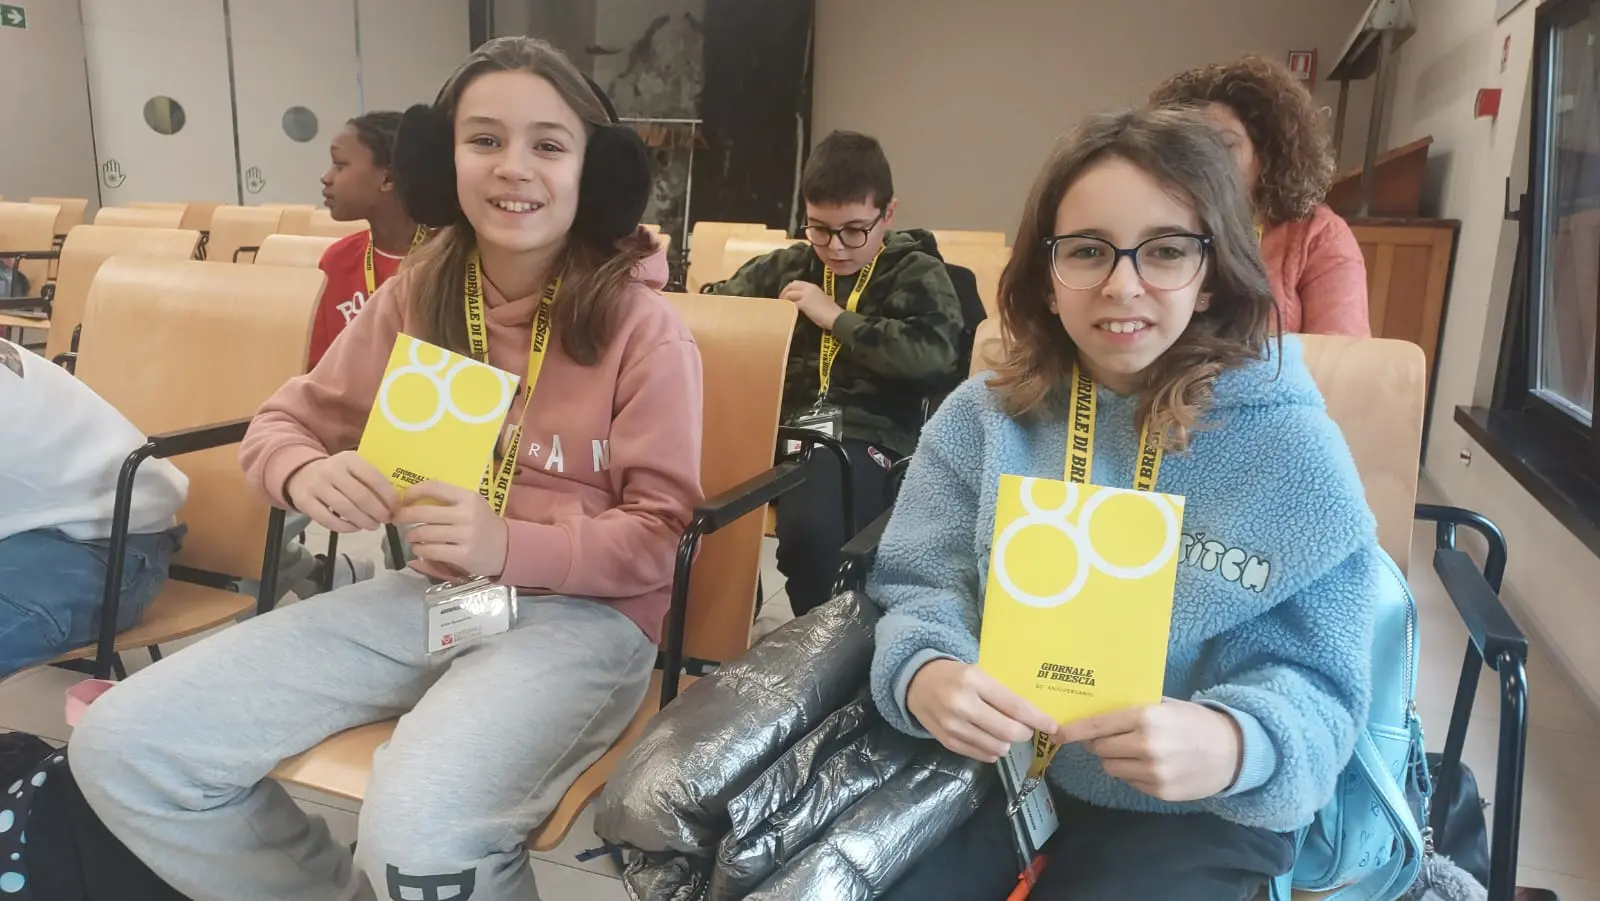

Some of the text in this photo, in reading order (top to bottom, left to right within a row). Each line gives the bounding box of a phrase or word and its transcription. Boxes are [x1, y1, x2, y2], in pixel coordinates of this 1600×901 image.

[467, 262, 481, 321] GIORNALE
[470, 322, 482, 337] DI
[1075, 375, 1094, 434] ORNALE
[1072, 436, 1090, 454] DI
[500, 477, 510, 492] DI
[1036, 670, 1096, 687] DI BRESCIA
[1041, 662, 1095, 678] GIORNALE
